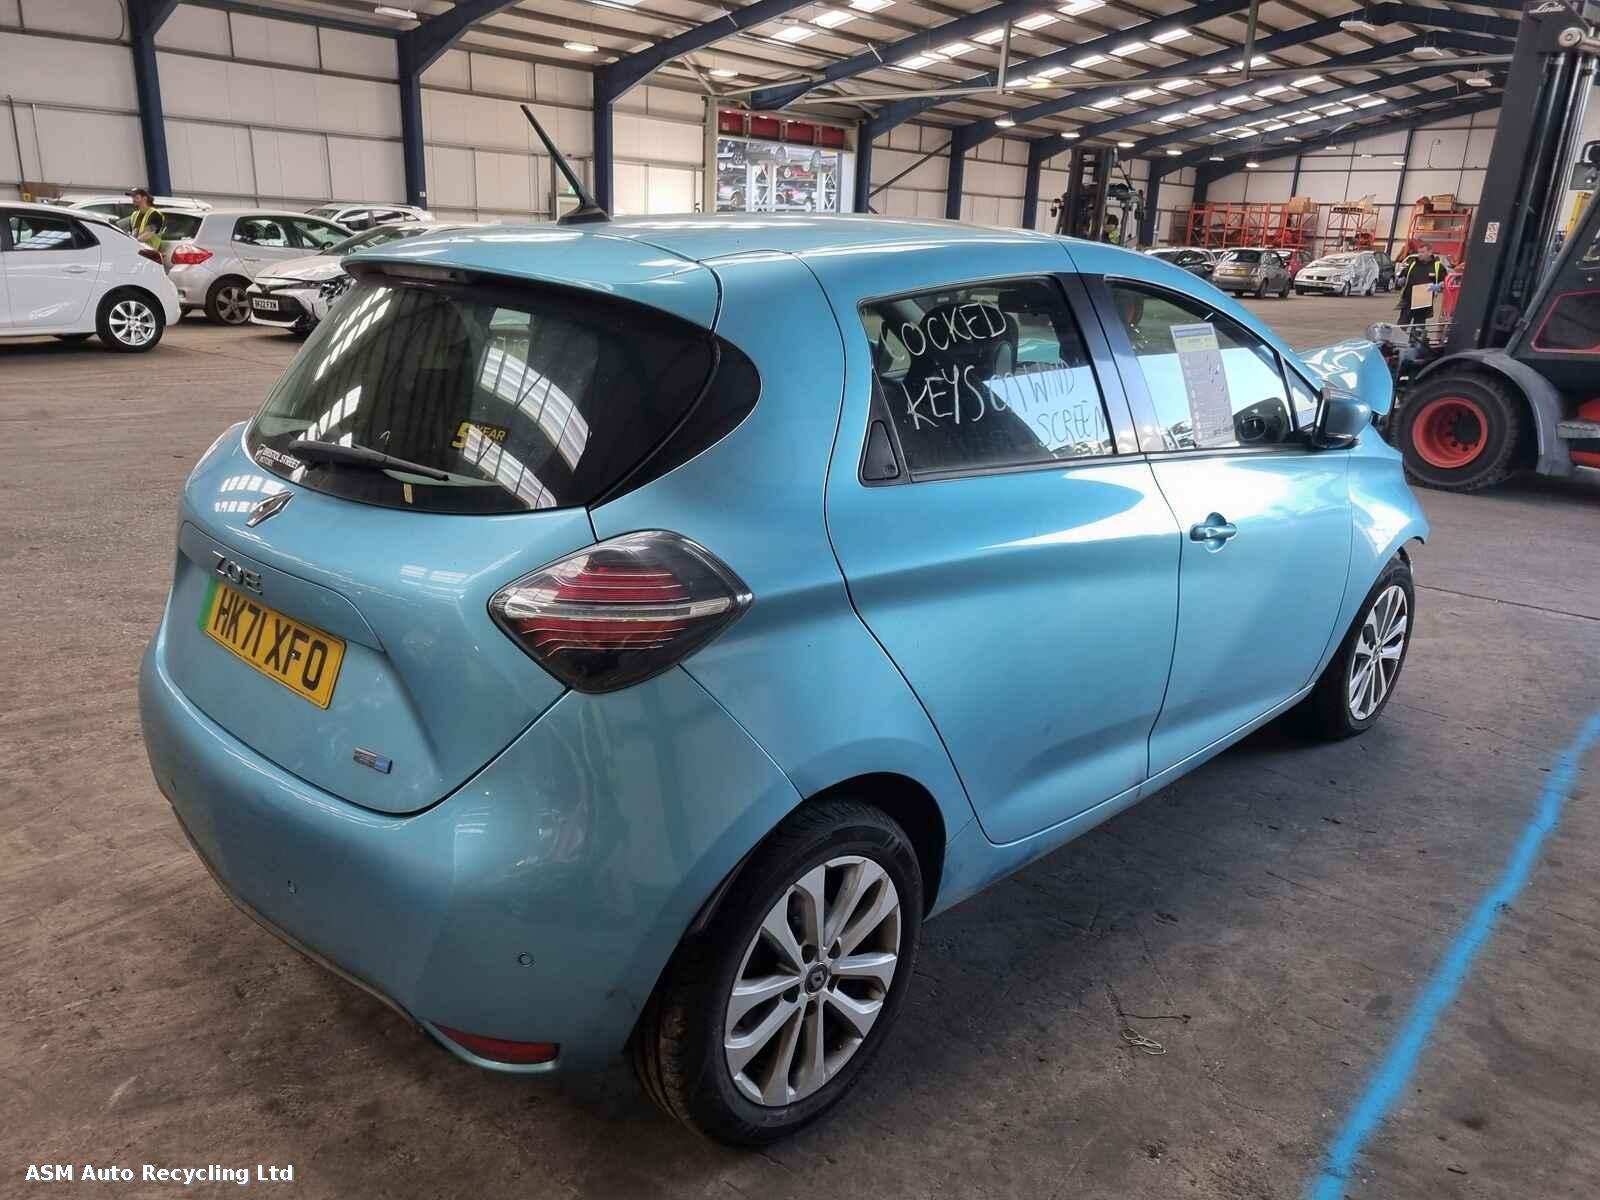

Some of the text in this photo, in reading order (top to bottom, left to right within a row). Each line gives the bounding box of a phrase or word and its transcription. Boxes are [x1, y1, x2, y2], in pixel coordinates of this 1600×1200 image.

[900, 364, 985, 430] KEYS
[212, 550, 262, 595] ZOE
[213, 587, 329, 692] HK71 XFO
